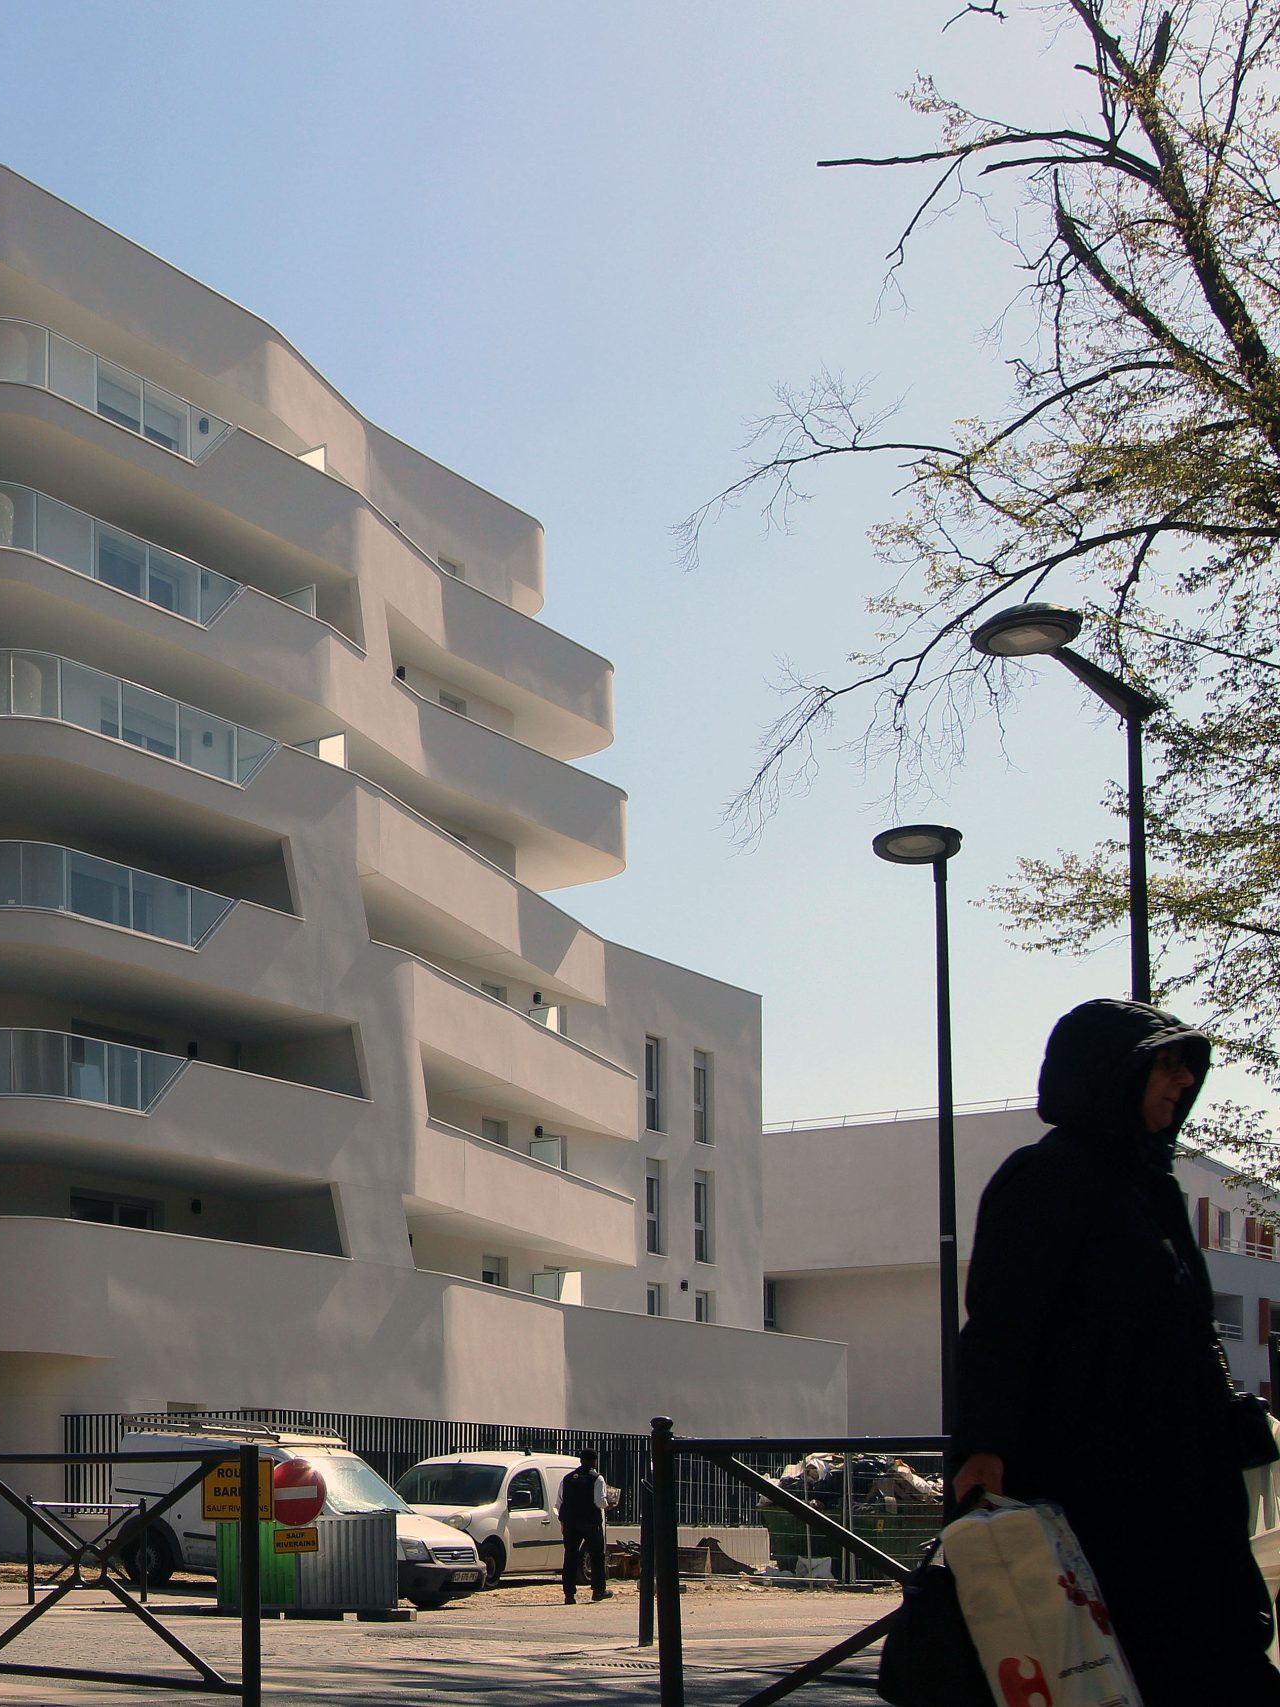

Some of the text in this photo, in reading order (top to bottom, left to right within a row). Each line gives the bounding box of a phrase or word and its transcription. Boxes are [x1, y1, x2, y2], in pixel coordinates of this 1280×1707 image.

[217, 1467, 241, 1479] ROU
[206, 1504, 227, 1513] SAUF
[286, 1531, 305, 1540] SAUF
[276, 1540, 316, 1548] RIVERAINS
